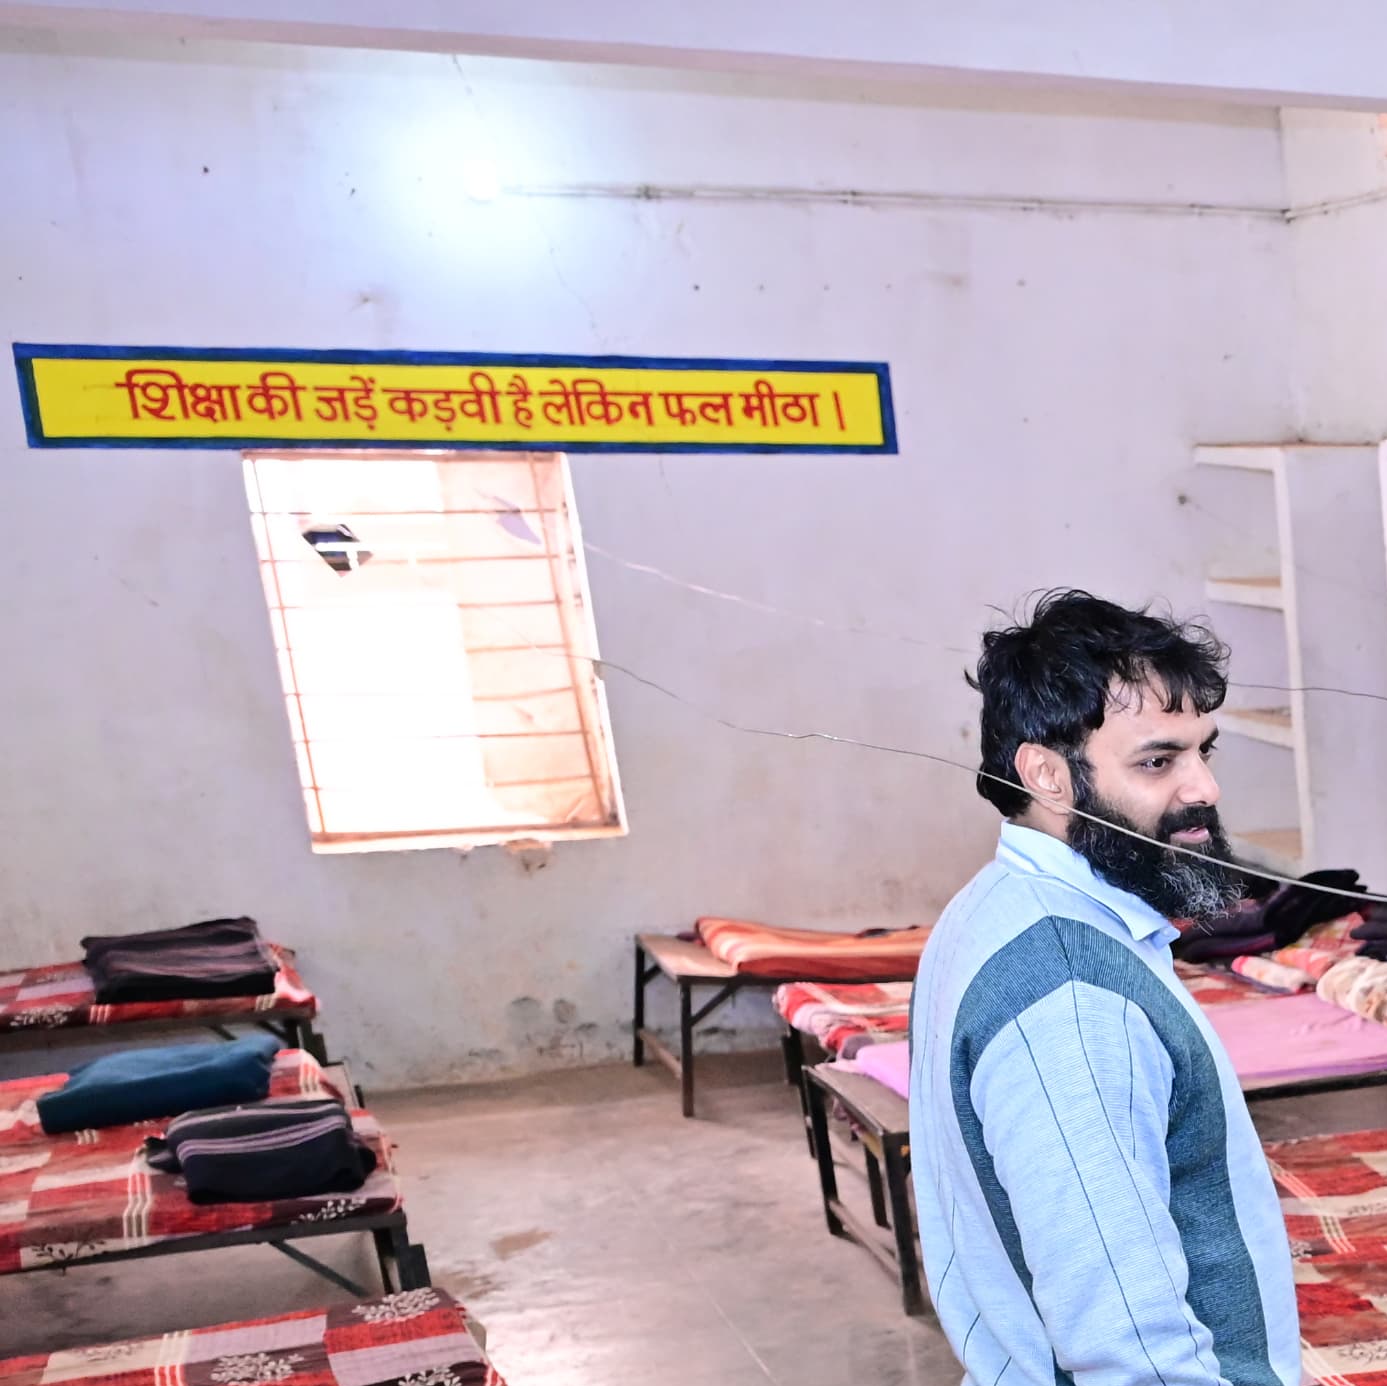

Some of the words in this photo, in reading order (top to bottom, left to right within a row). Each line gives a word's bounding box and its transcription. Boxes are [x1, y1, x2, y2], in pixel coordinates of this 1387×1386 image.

[114, 369, 242, 423] शिक्षा
[246, 371, 306, 422] की
[313, 376, 379, 431] जड़ें
[382, 372, 502, 432] कड़वी
[505, 374, 534, 429] है
[538, 378, 654, 427] लेकिन
[658, 391, 734, 428] फल
[738, 379, 820, 428] मीठा
